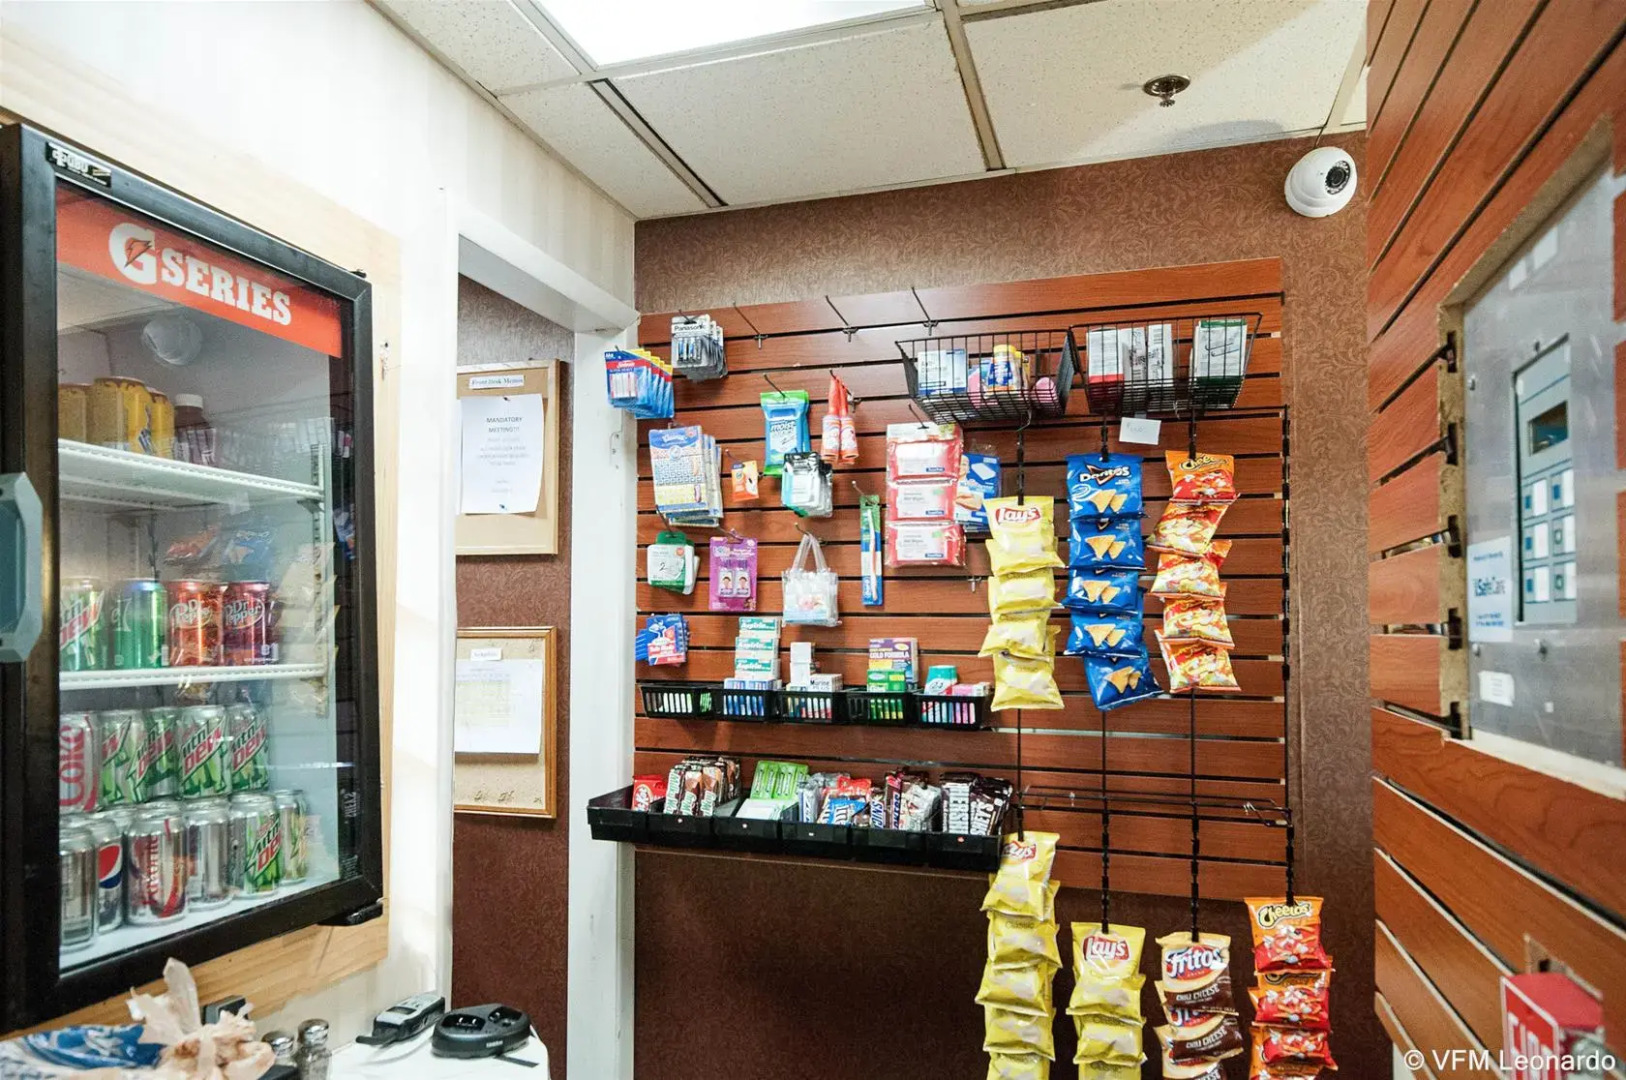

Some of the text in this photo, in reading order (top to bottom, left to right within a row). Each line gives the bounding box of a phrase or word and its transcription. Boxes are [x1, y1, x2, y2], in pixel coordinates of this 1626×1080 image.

[108, 222, 292, 327] G SERIES
[674, 324, 704, 332] Panasonic
[486, 416, 523, 424] MANDATORY
[1080, 466, 1130, 482] Doritos
[872, 800, 884, 828] SNIC
[1259, 902, 1311, 928] Cheetos
[1165, 948, 1223, 979] Fritos
